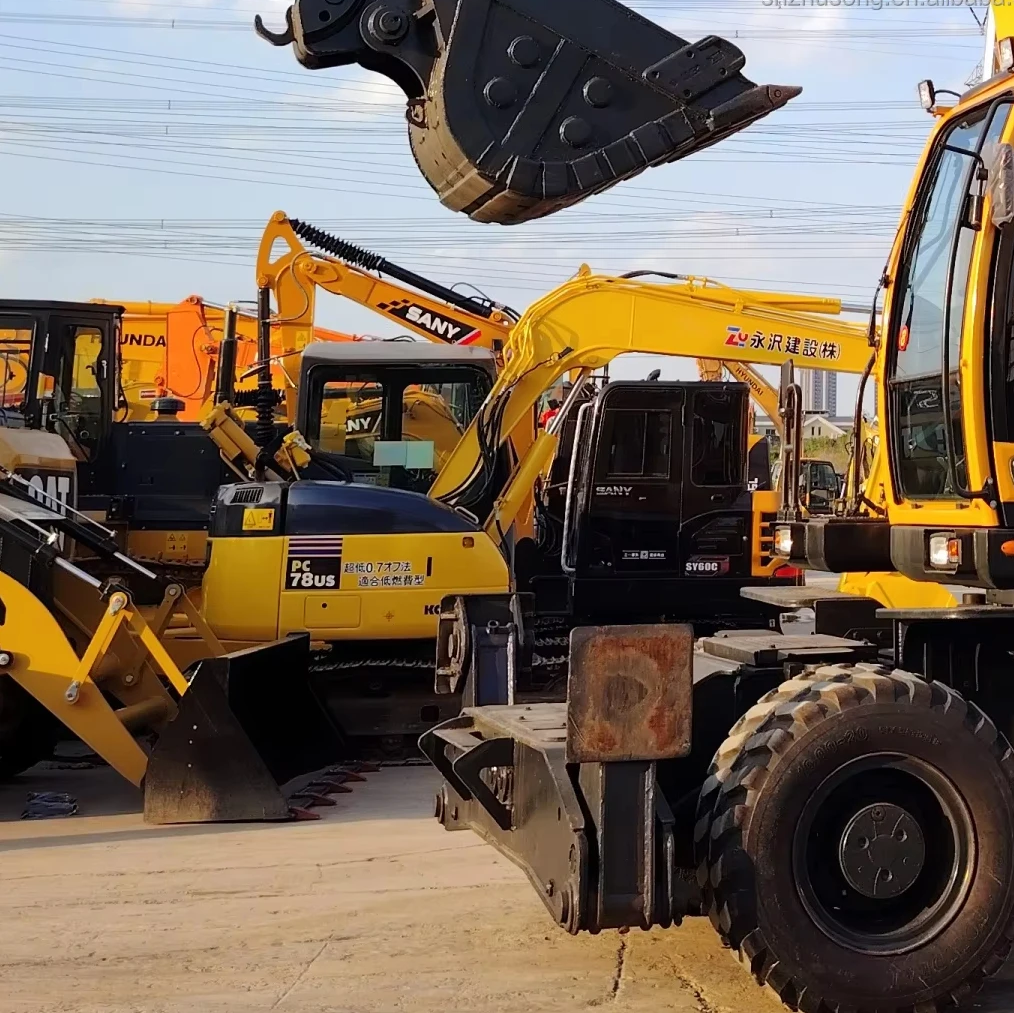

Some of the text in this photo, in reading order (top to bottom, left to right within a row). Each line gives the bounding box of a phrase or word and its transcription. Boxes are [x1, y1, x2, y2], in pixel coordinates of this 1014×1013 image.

[406, 305, 461, 339] SANY
[735, 367, 764, 396] HYUNDAI
[595, 486, 633, 496] SANY
[291, 560, 311, 572] PC
